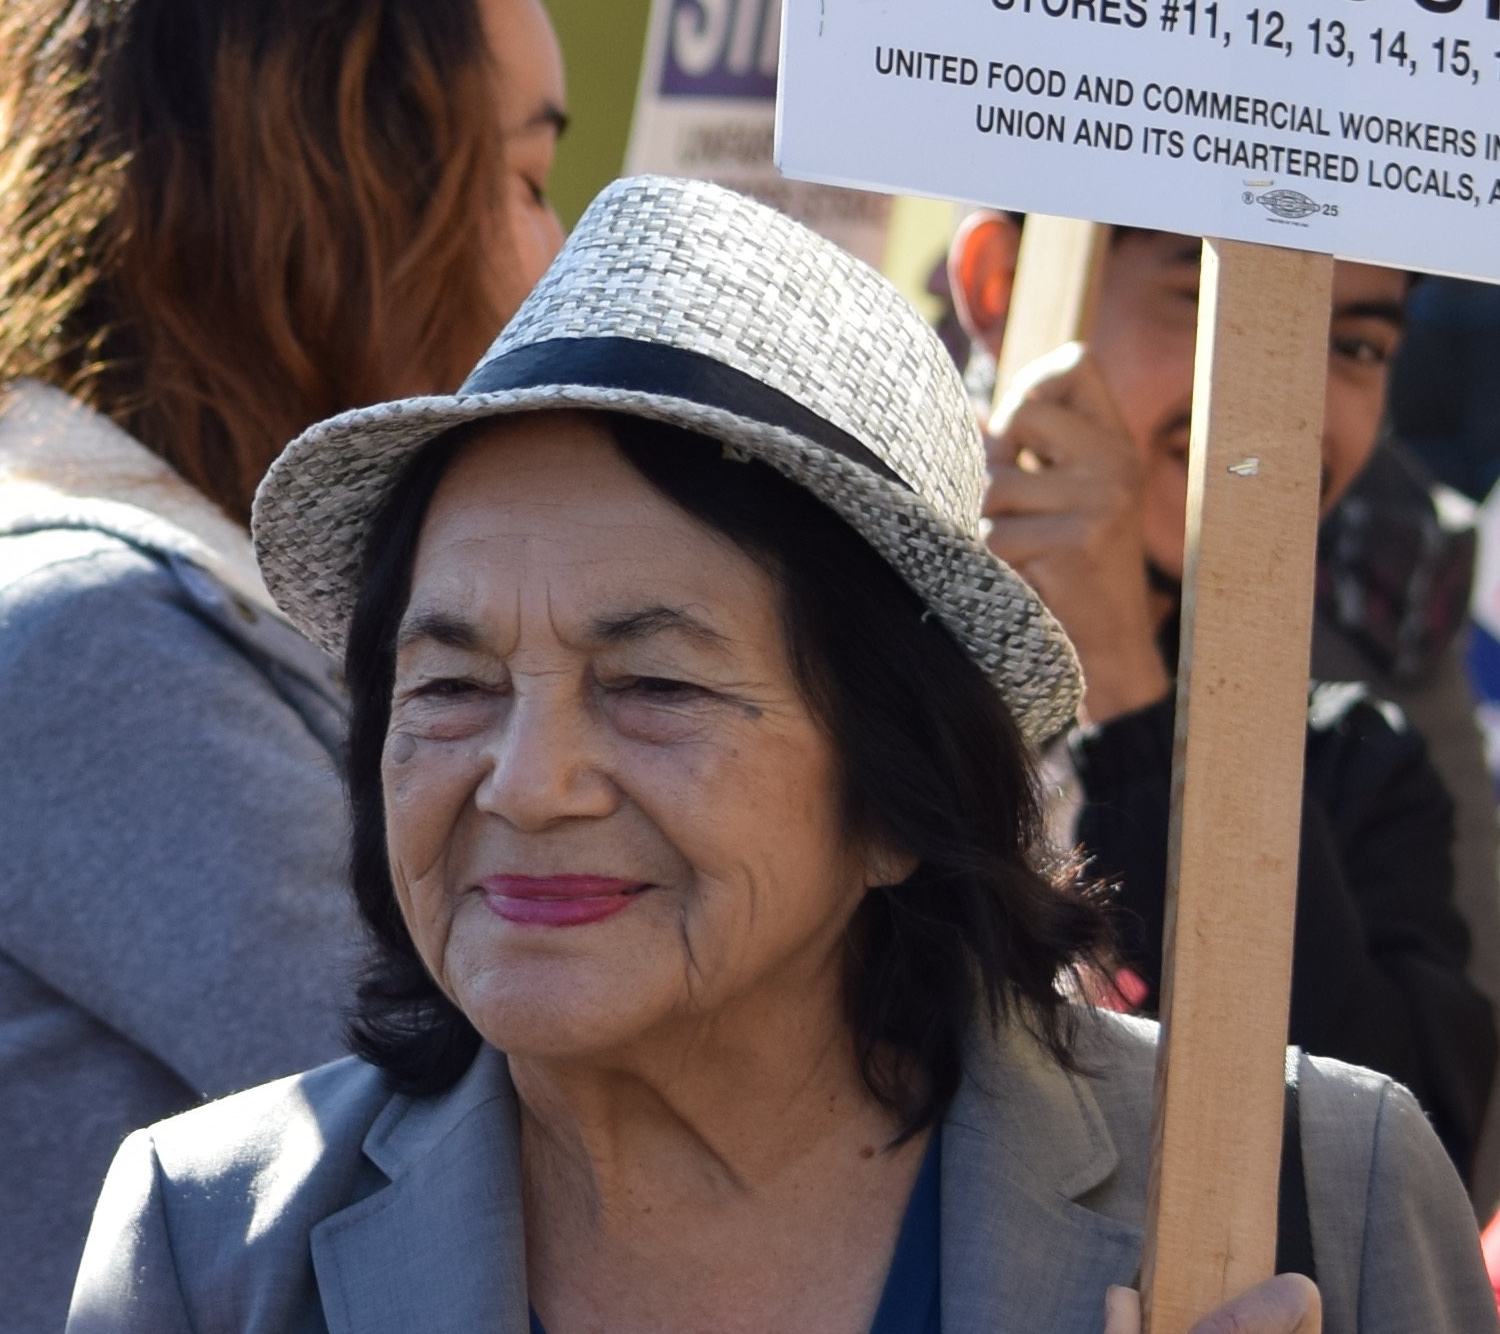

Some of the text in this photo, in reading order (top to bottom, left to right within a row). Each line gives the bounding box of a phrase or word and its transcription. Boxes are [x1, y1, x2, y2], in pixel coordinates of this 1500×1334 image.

[1247, 9, 1292, 57] 12,
[1308, 18, 1354, 67] 13,
[1370, 28, 1417, 76] 14,
[1433, 37, 1479, 85] 15,
[876, 46, 978, 86] UNITED
[988, 61, 1066, 98] FOOD
[1074, 74, 1134, 107] AND
[1143, 83, 1330, 136] COMMERCIAL
[1339, 112, 1476, 158] WORKERS
[976, 104, 1065, 143] UNION
[1076, 119, 1133, 151] AND
[1143, 127, 1184, 158] ITS
[1193, 134, 1358, 183] CHARTERED
[1368, 160, 1480, 206] LOCALS,
[1322, 203, 1338, 216] 25
